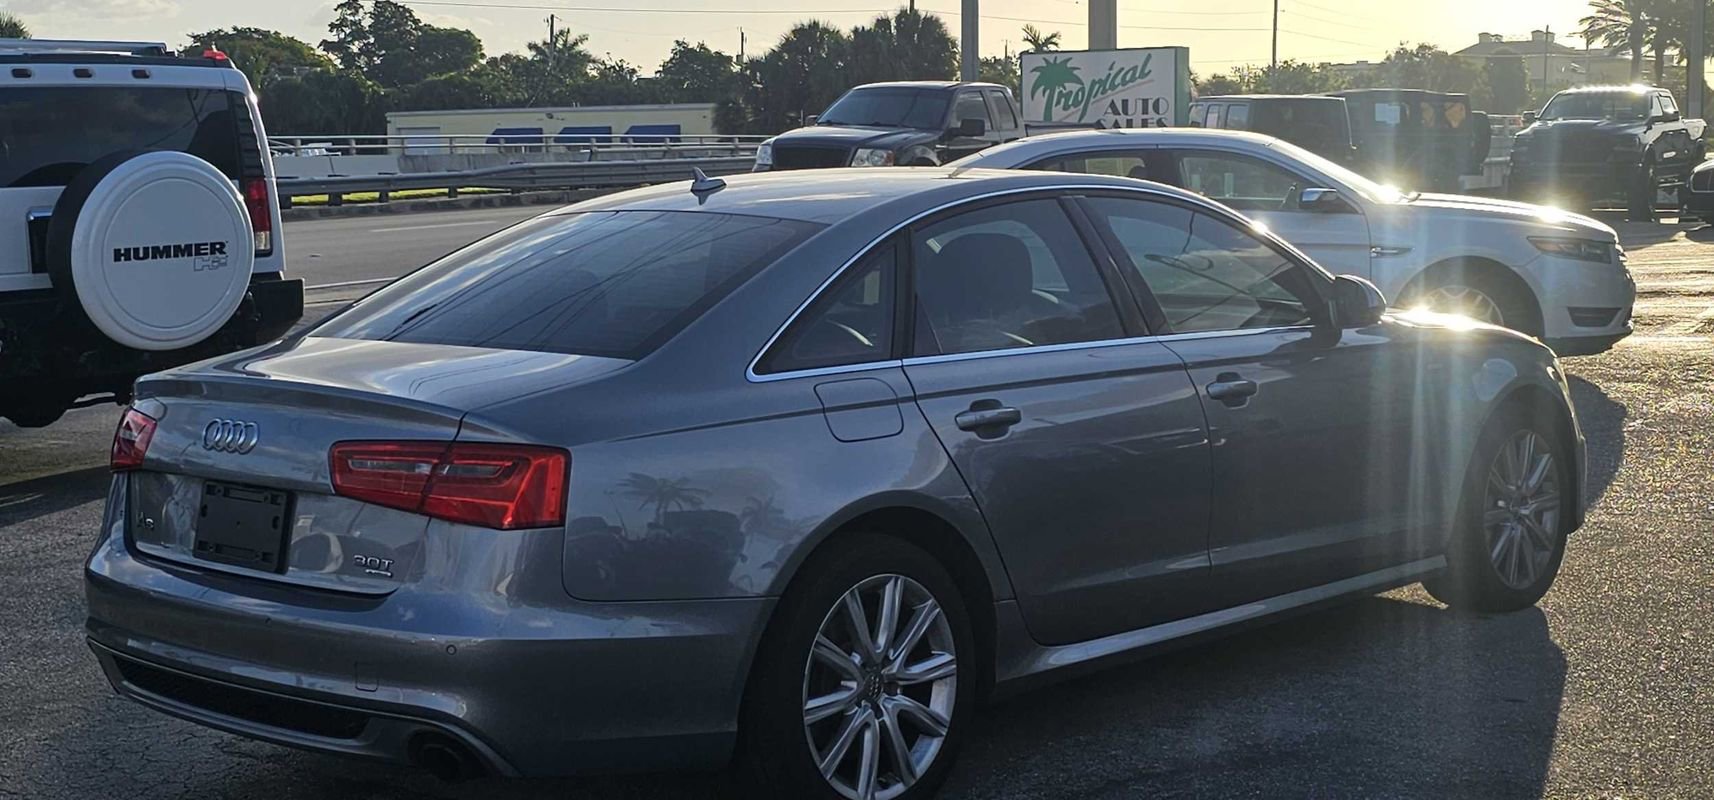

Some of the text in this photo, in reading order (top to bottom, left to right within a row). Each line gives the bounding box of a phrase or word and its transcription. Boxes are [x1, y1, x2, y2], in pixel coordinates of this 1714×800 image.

[1031, 53, 1152, 122] Tropical
[1103, 97, 1169, 116] AUTO
[113, 241, 227, 263] HUMMER
